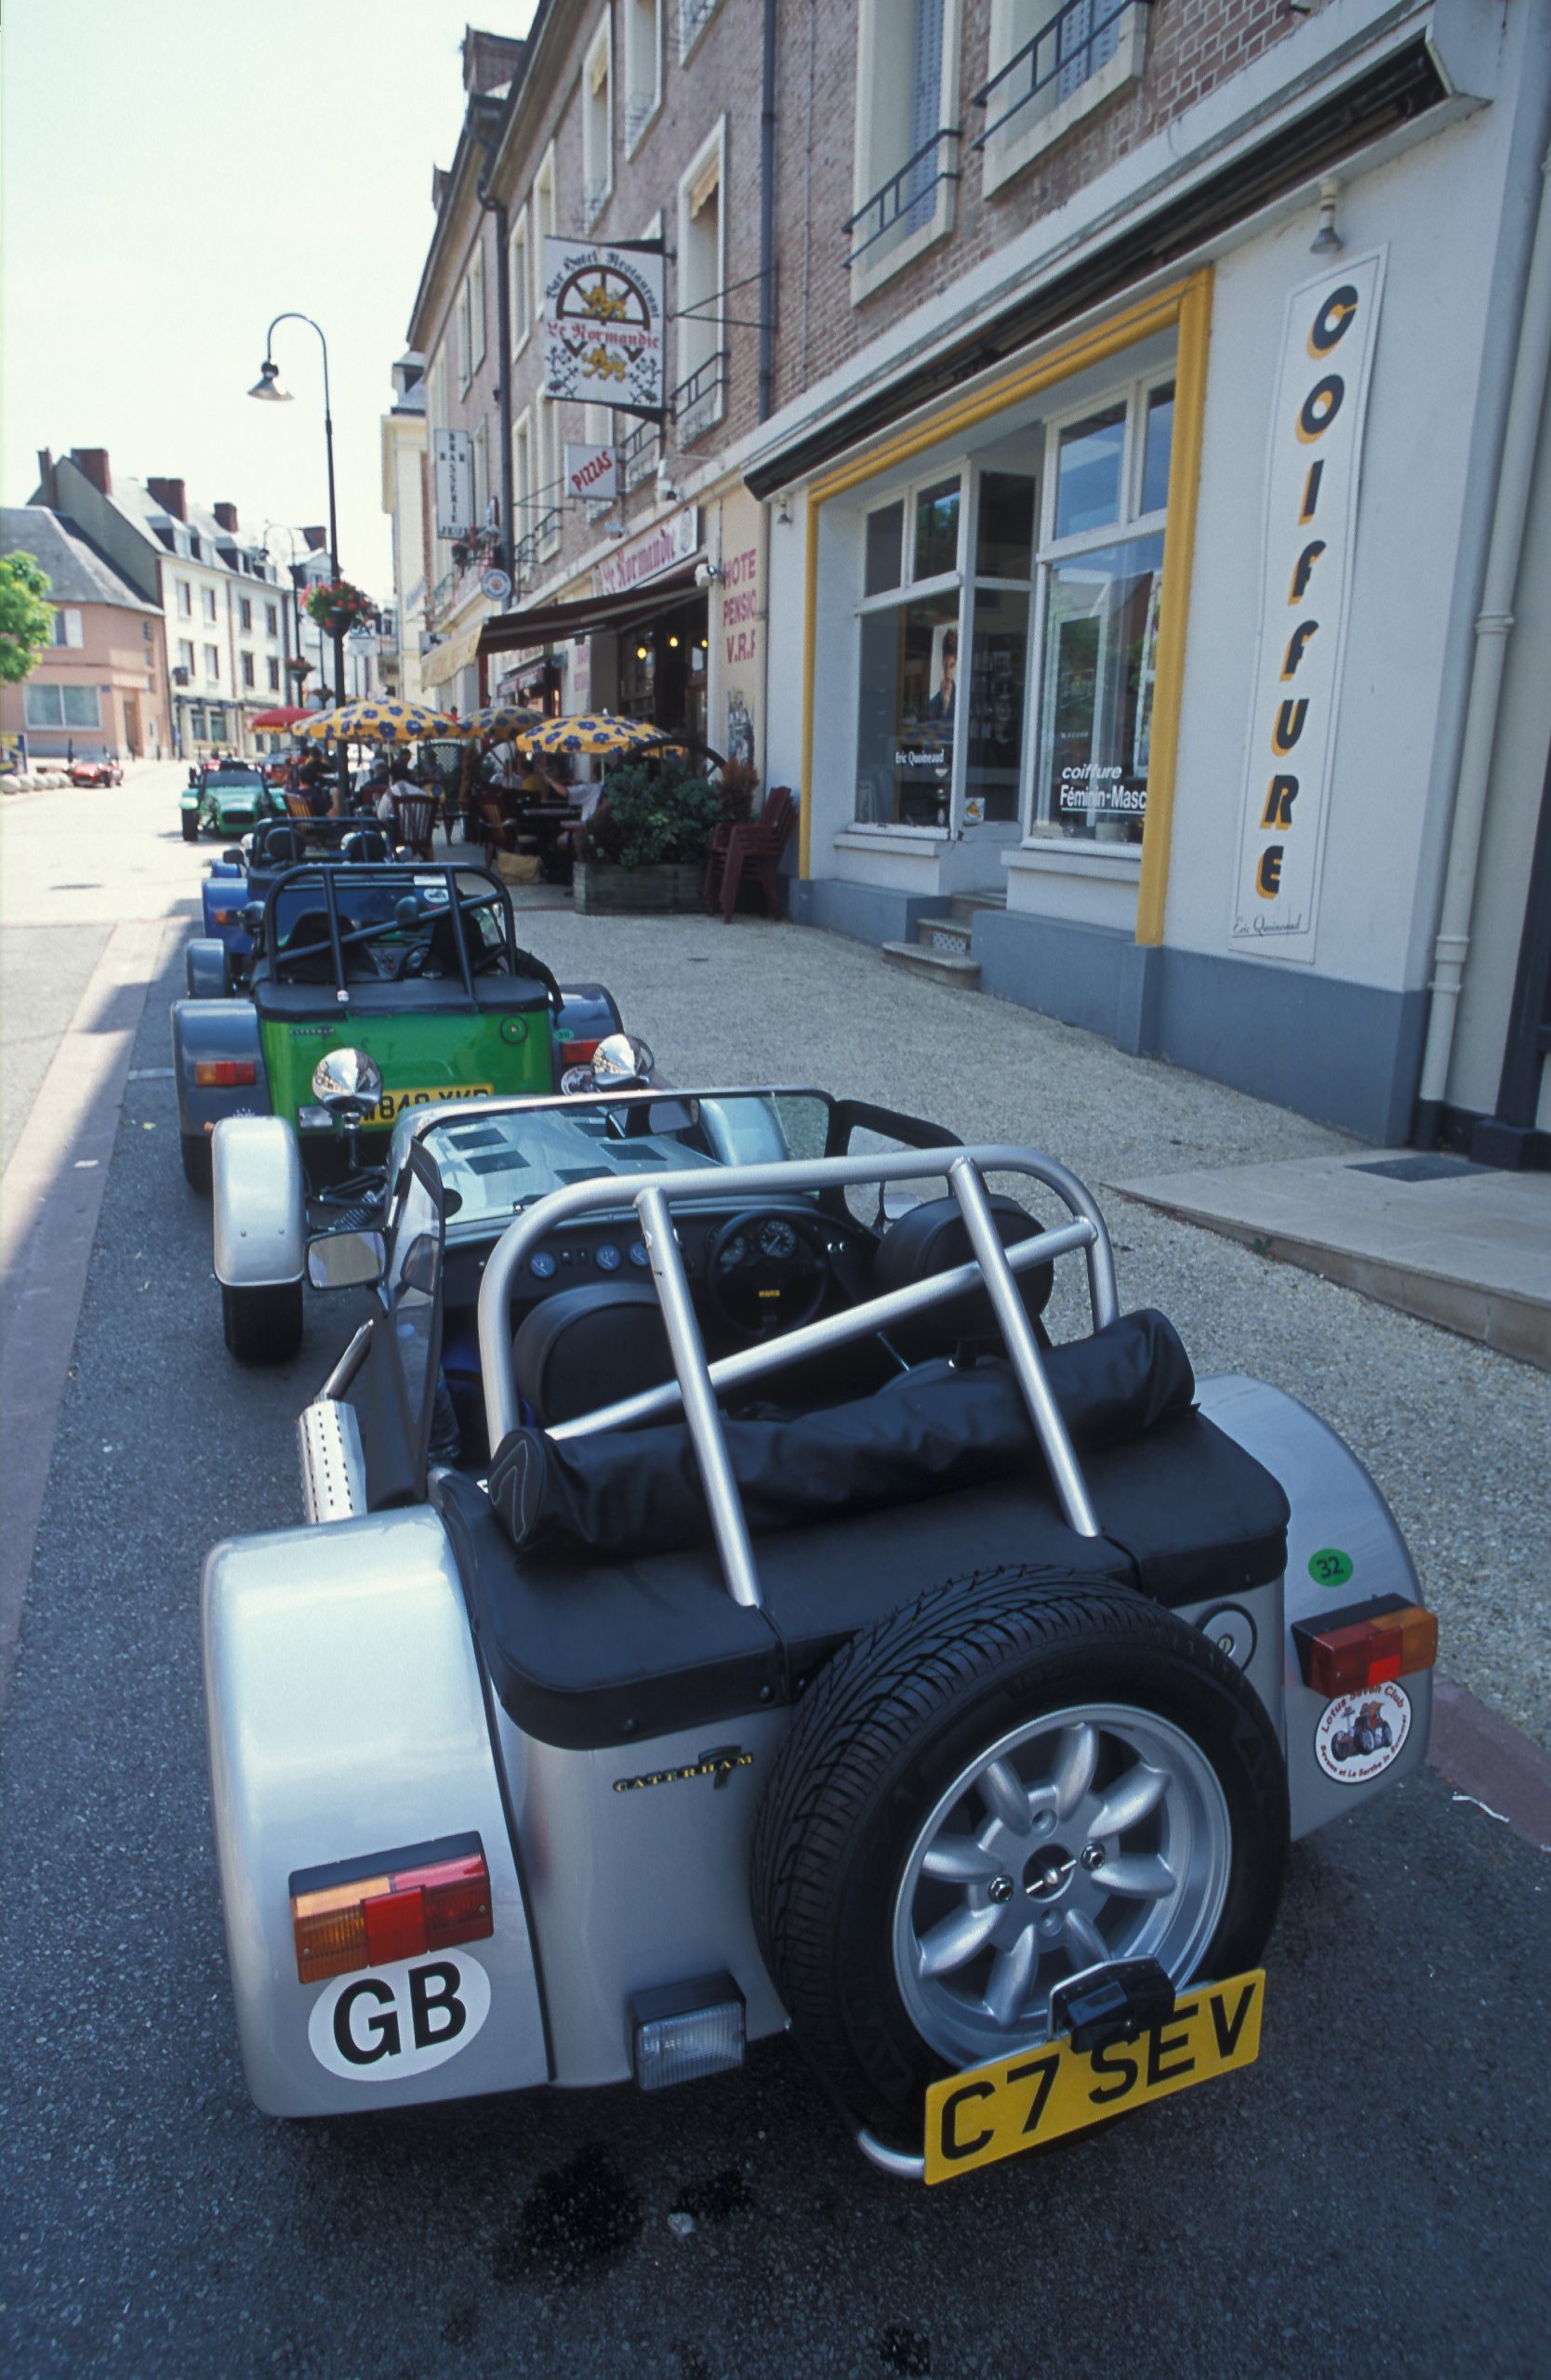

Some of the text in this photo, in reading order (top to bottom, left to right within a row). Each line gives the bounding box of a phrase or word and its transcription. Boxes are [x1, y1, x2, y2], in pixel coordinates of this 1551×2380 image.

[571, 450, 613, 492] PIZZAS
[1256, 284, 1359, 899] COIFFURE
[1062, 763, 1122, 780] coiffure
[1316, 1555, 1345, 1580] 32
[1321, 1698, 1346, 1734] Lotus
[1384, 1686, 1405, 1708] Club
[613, 1752, 754, 1792] CATERHAM
[333, 1961, 467, 2065] GB
[941, 1983, 1256, 2161] C7 SEV
